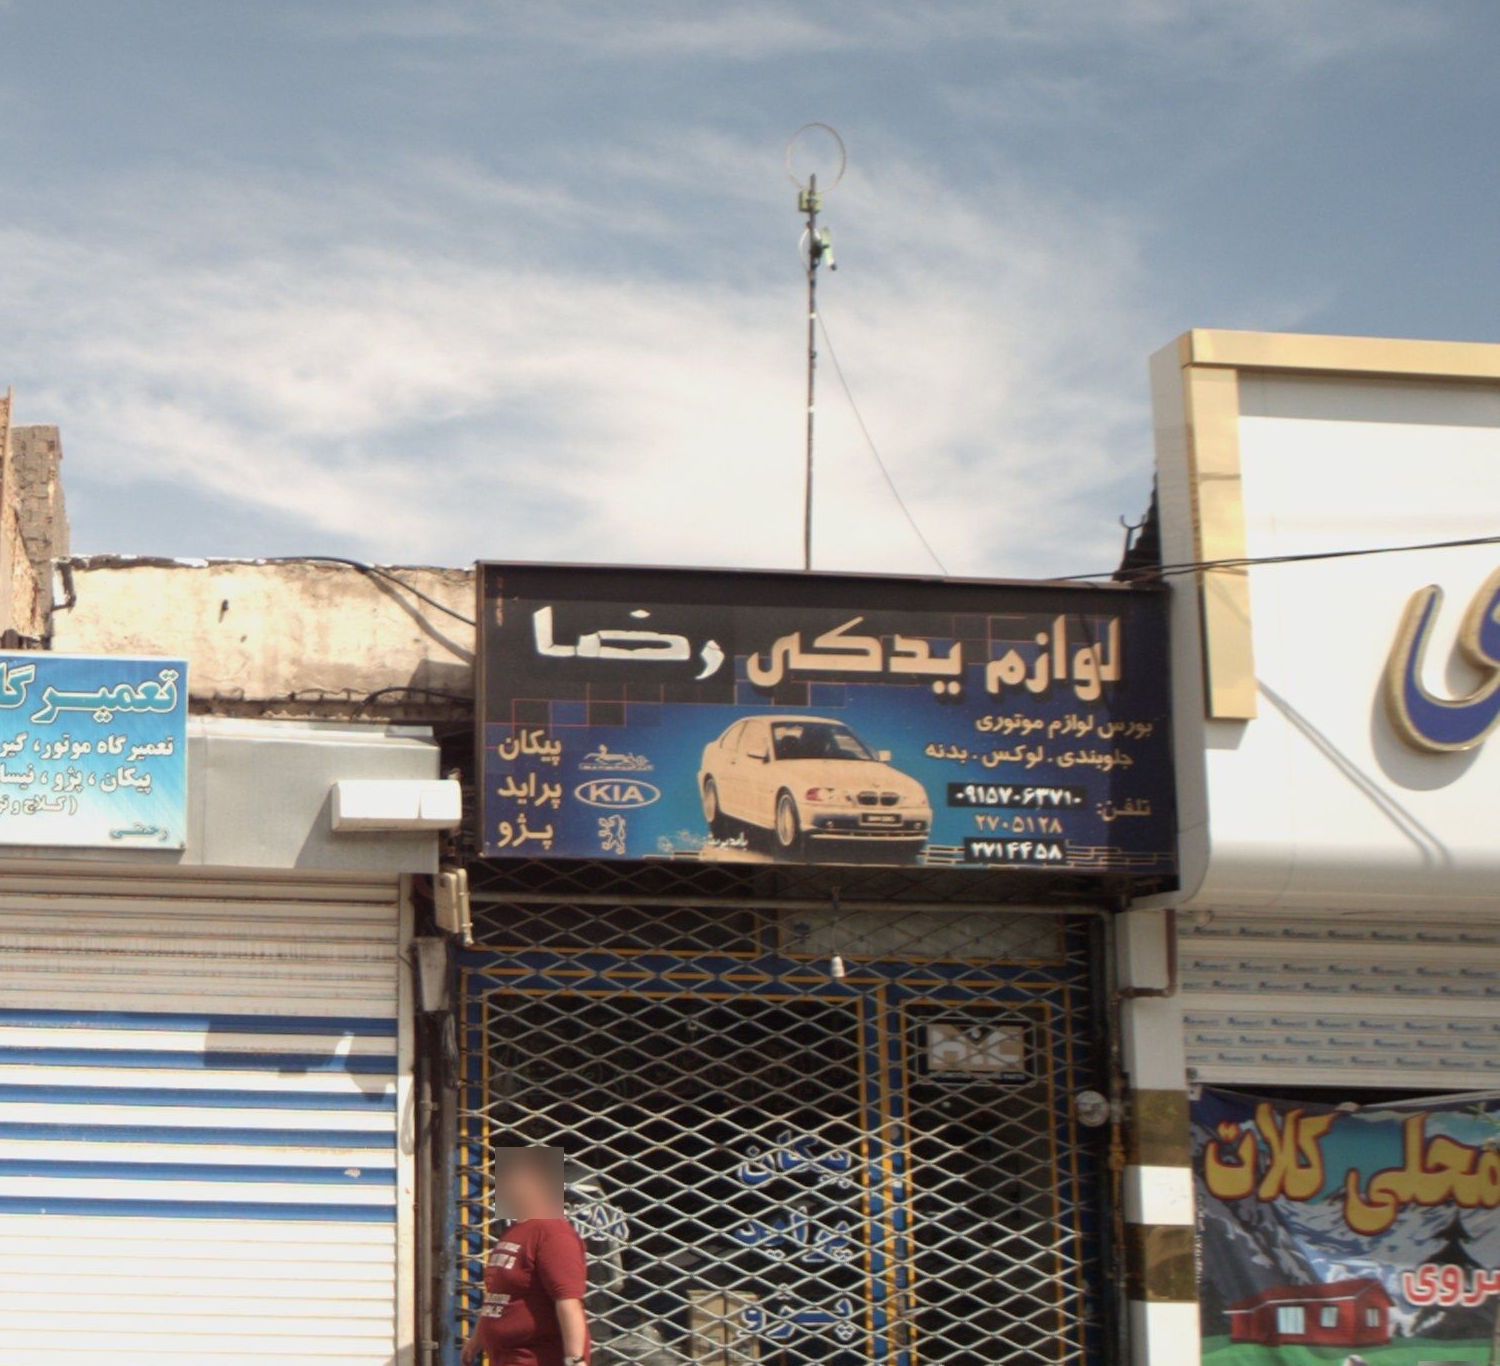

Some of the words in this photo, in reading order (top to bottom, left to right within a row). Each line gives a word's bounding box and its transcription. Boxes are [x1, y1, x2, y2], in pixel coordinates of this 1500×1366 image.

[532, 605, 726, 681] رضا
[746, 615, 963, 696] یدکی
[985, 613, 1121, 702] لوازم
[974, 712, 1044, 736] موتوری
[1047, 713, 1095, 740] لوازم
[1096, 719, 1153, 740] بورس
[497, 728, 562, 766] پیکان
[924, 742, 969, 764] بدنه
[980, 744, 1045, 769] لوکس
[1055, 747, 1134, 772] جلوبندی
[52, 766, 84, 793] پژو
[100, 766, 153, 794] پیکان
[496, 771, 563, 810] پراید
[588, 784, 646, 803] KIA
[496, 812, 554, 851] پژو
[973, 813, 1064, 835] ۲۷۰۵۱۲۸
[970, 841, 1064, 861] ۲۷۱۴۴۵۸
[1204, 1101, 1338, 1202] کلات
